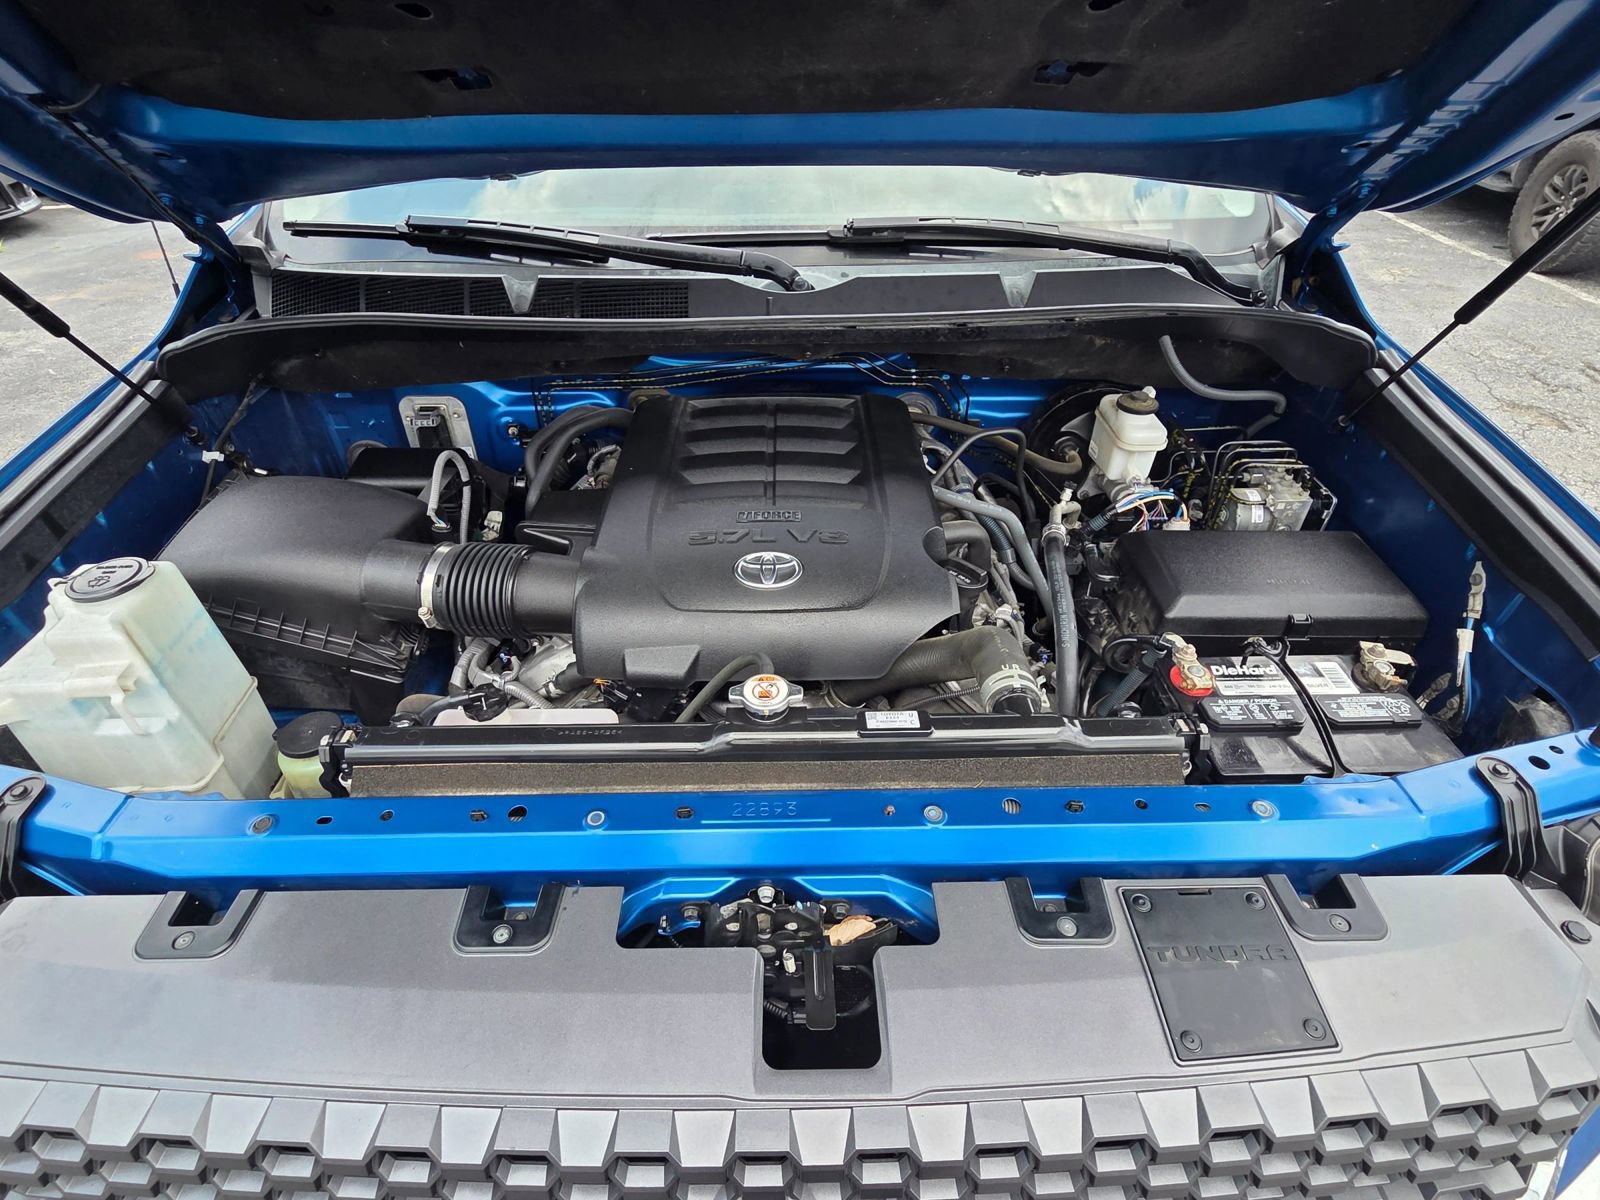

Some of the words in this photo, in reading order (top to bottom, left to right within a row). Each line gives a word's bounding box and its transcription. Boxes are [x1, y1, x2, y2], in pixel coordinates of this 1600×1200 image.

[688, 528, 777, 546] 5.7L
[786, 528, 849, 544] V8
[1210, 664, 1278, 676] DieHard
[1147, 944, 1293, 963] TUNDRA
